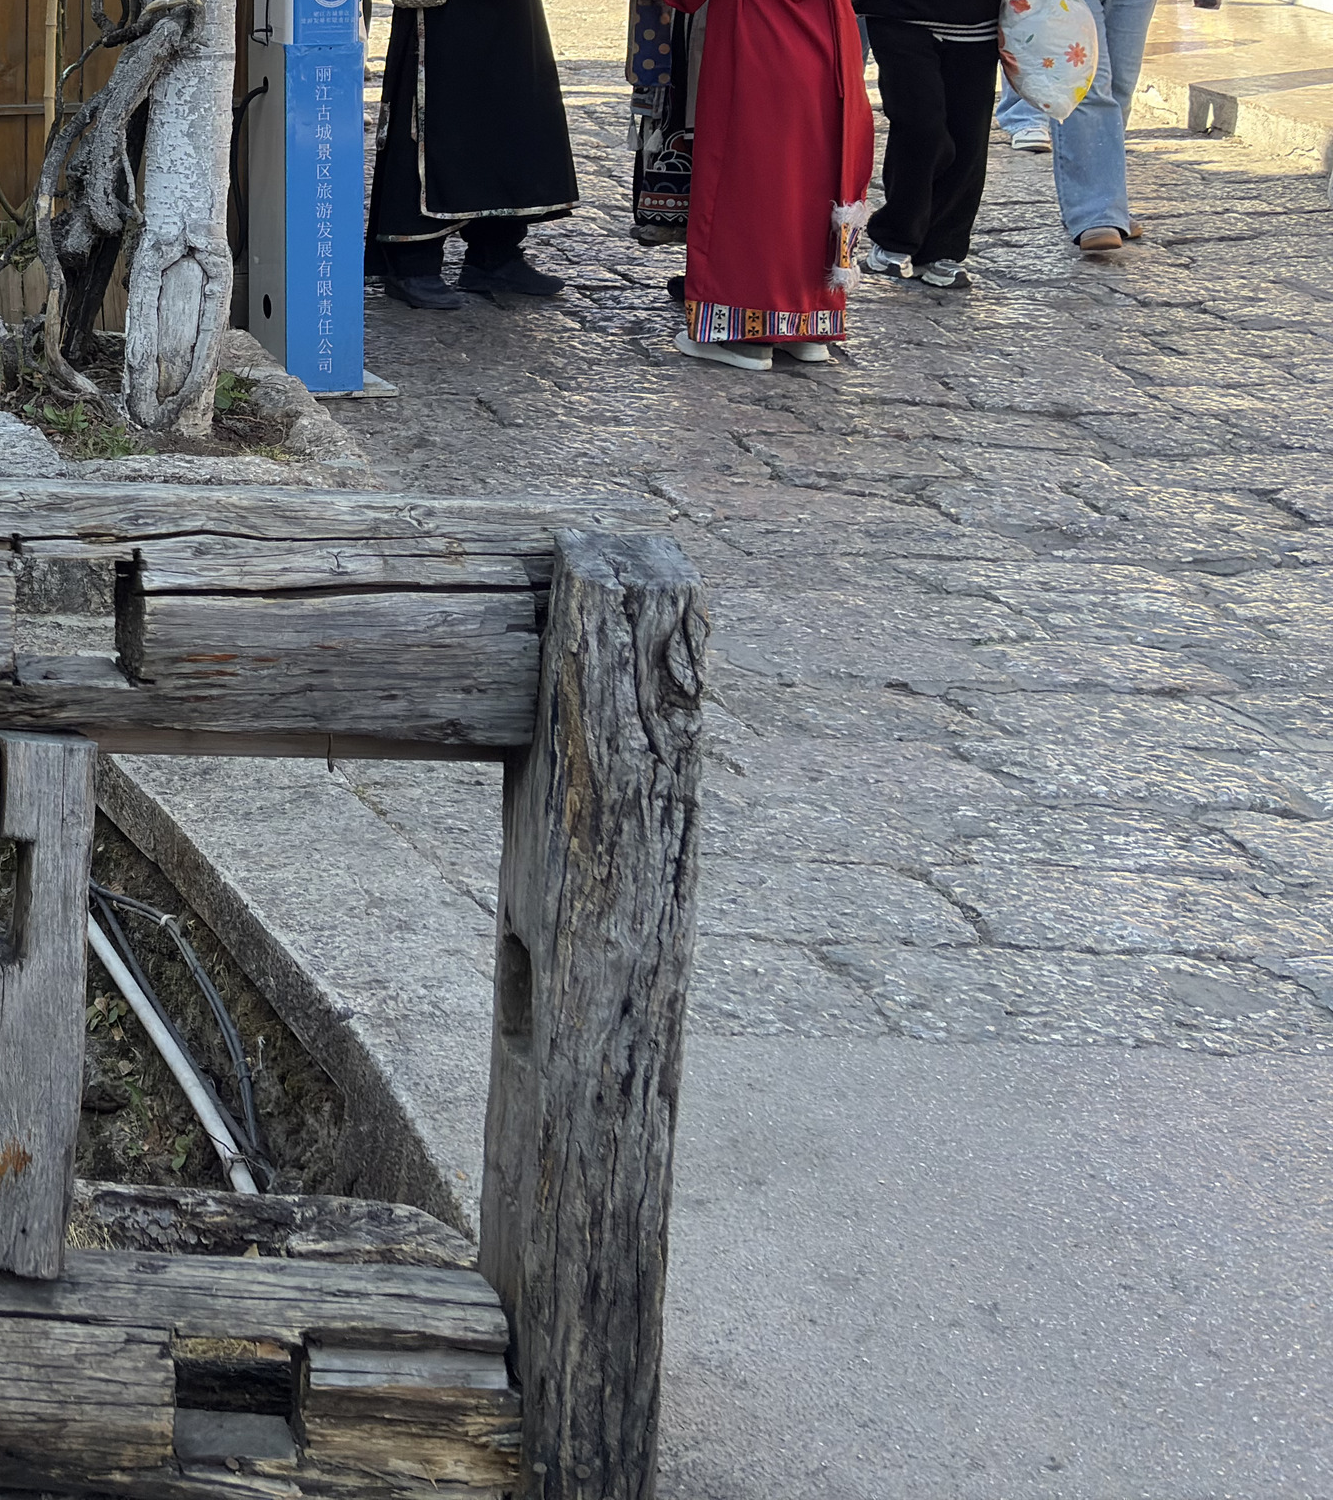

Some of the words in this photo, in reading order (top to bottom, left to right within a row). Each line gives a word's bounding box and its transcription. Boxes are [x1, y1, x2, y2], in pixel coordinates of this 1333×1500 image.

[315, 65, 333, 374] 丽江古城景区旅游发展有限责任公司
